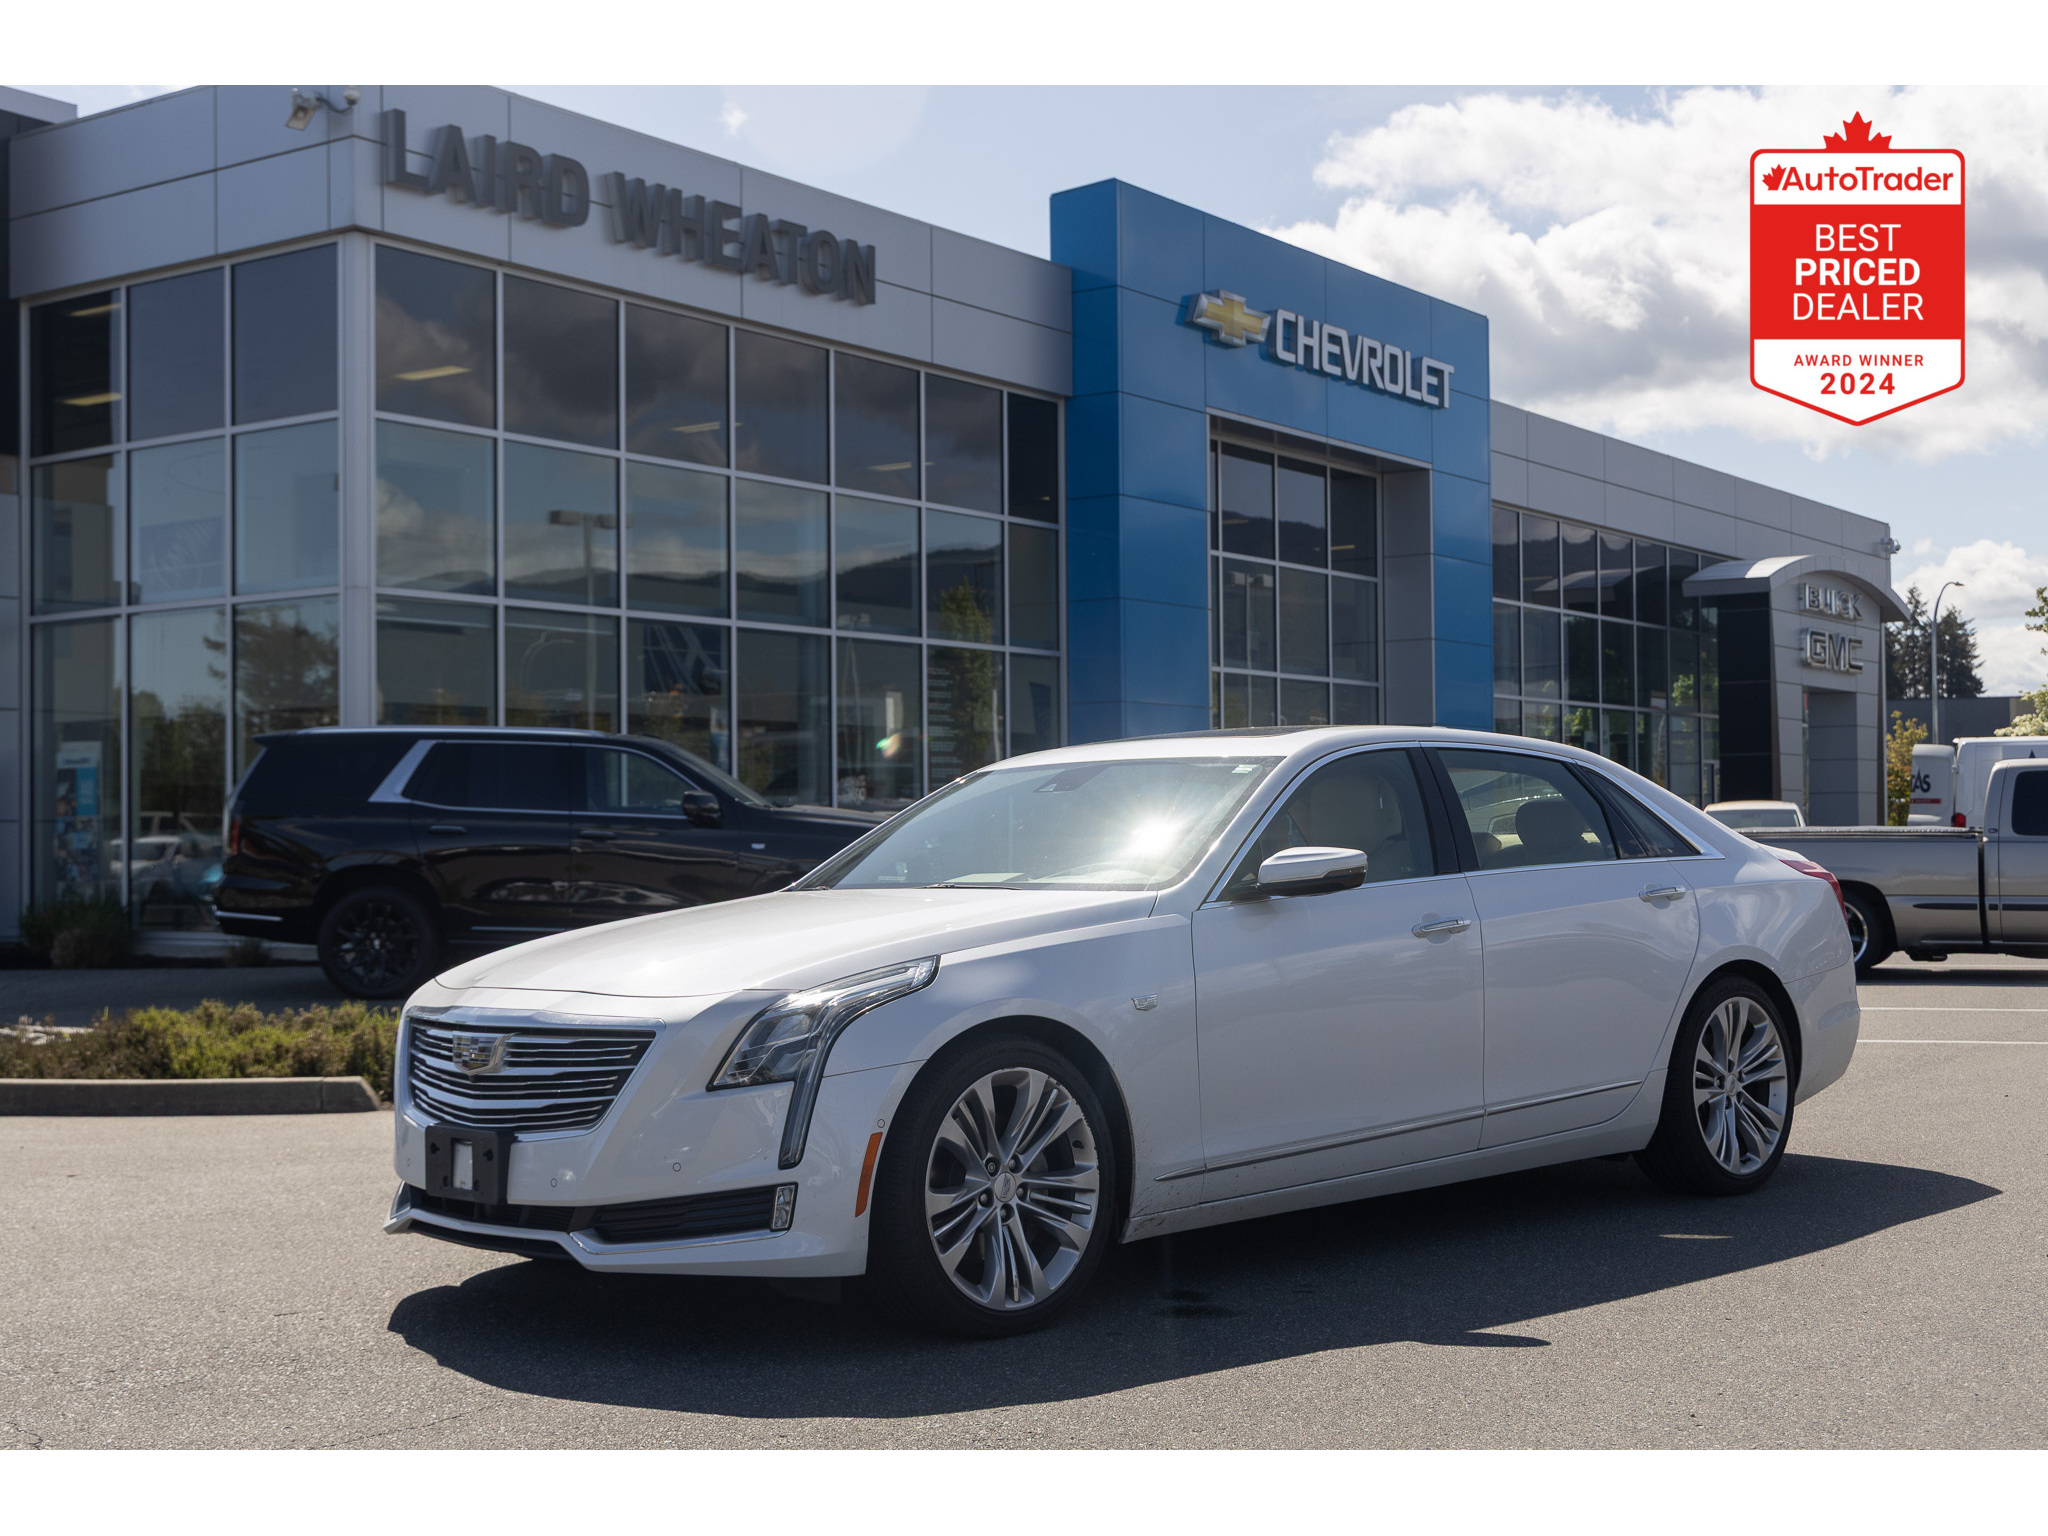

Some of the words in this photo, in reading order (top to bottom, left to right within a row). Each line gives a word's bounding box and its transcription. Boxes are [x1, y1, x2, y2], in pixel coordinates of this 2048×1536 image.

[382, 108, 590, 228] LAIRD
[603, 170, 877, 306] WHEATON
[1274, 308, 1455, 409] CHEVROLET
[1804, 583, 1862, 620] BUICK
[1805, 629, 1864, 674] GMC
